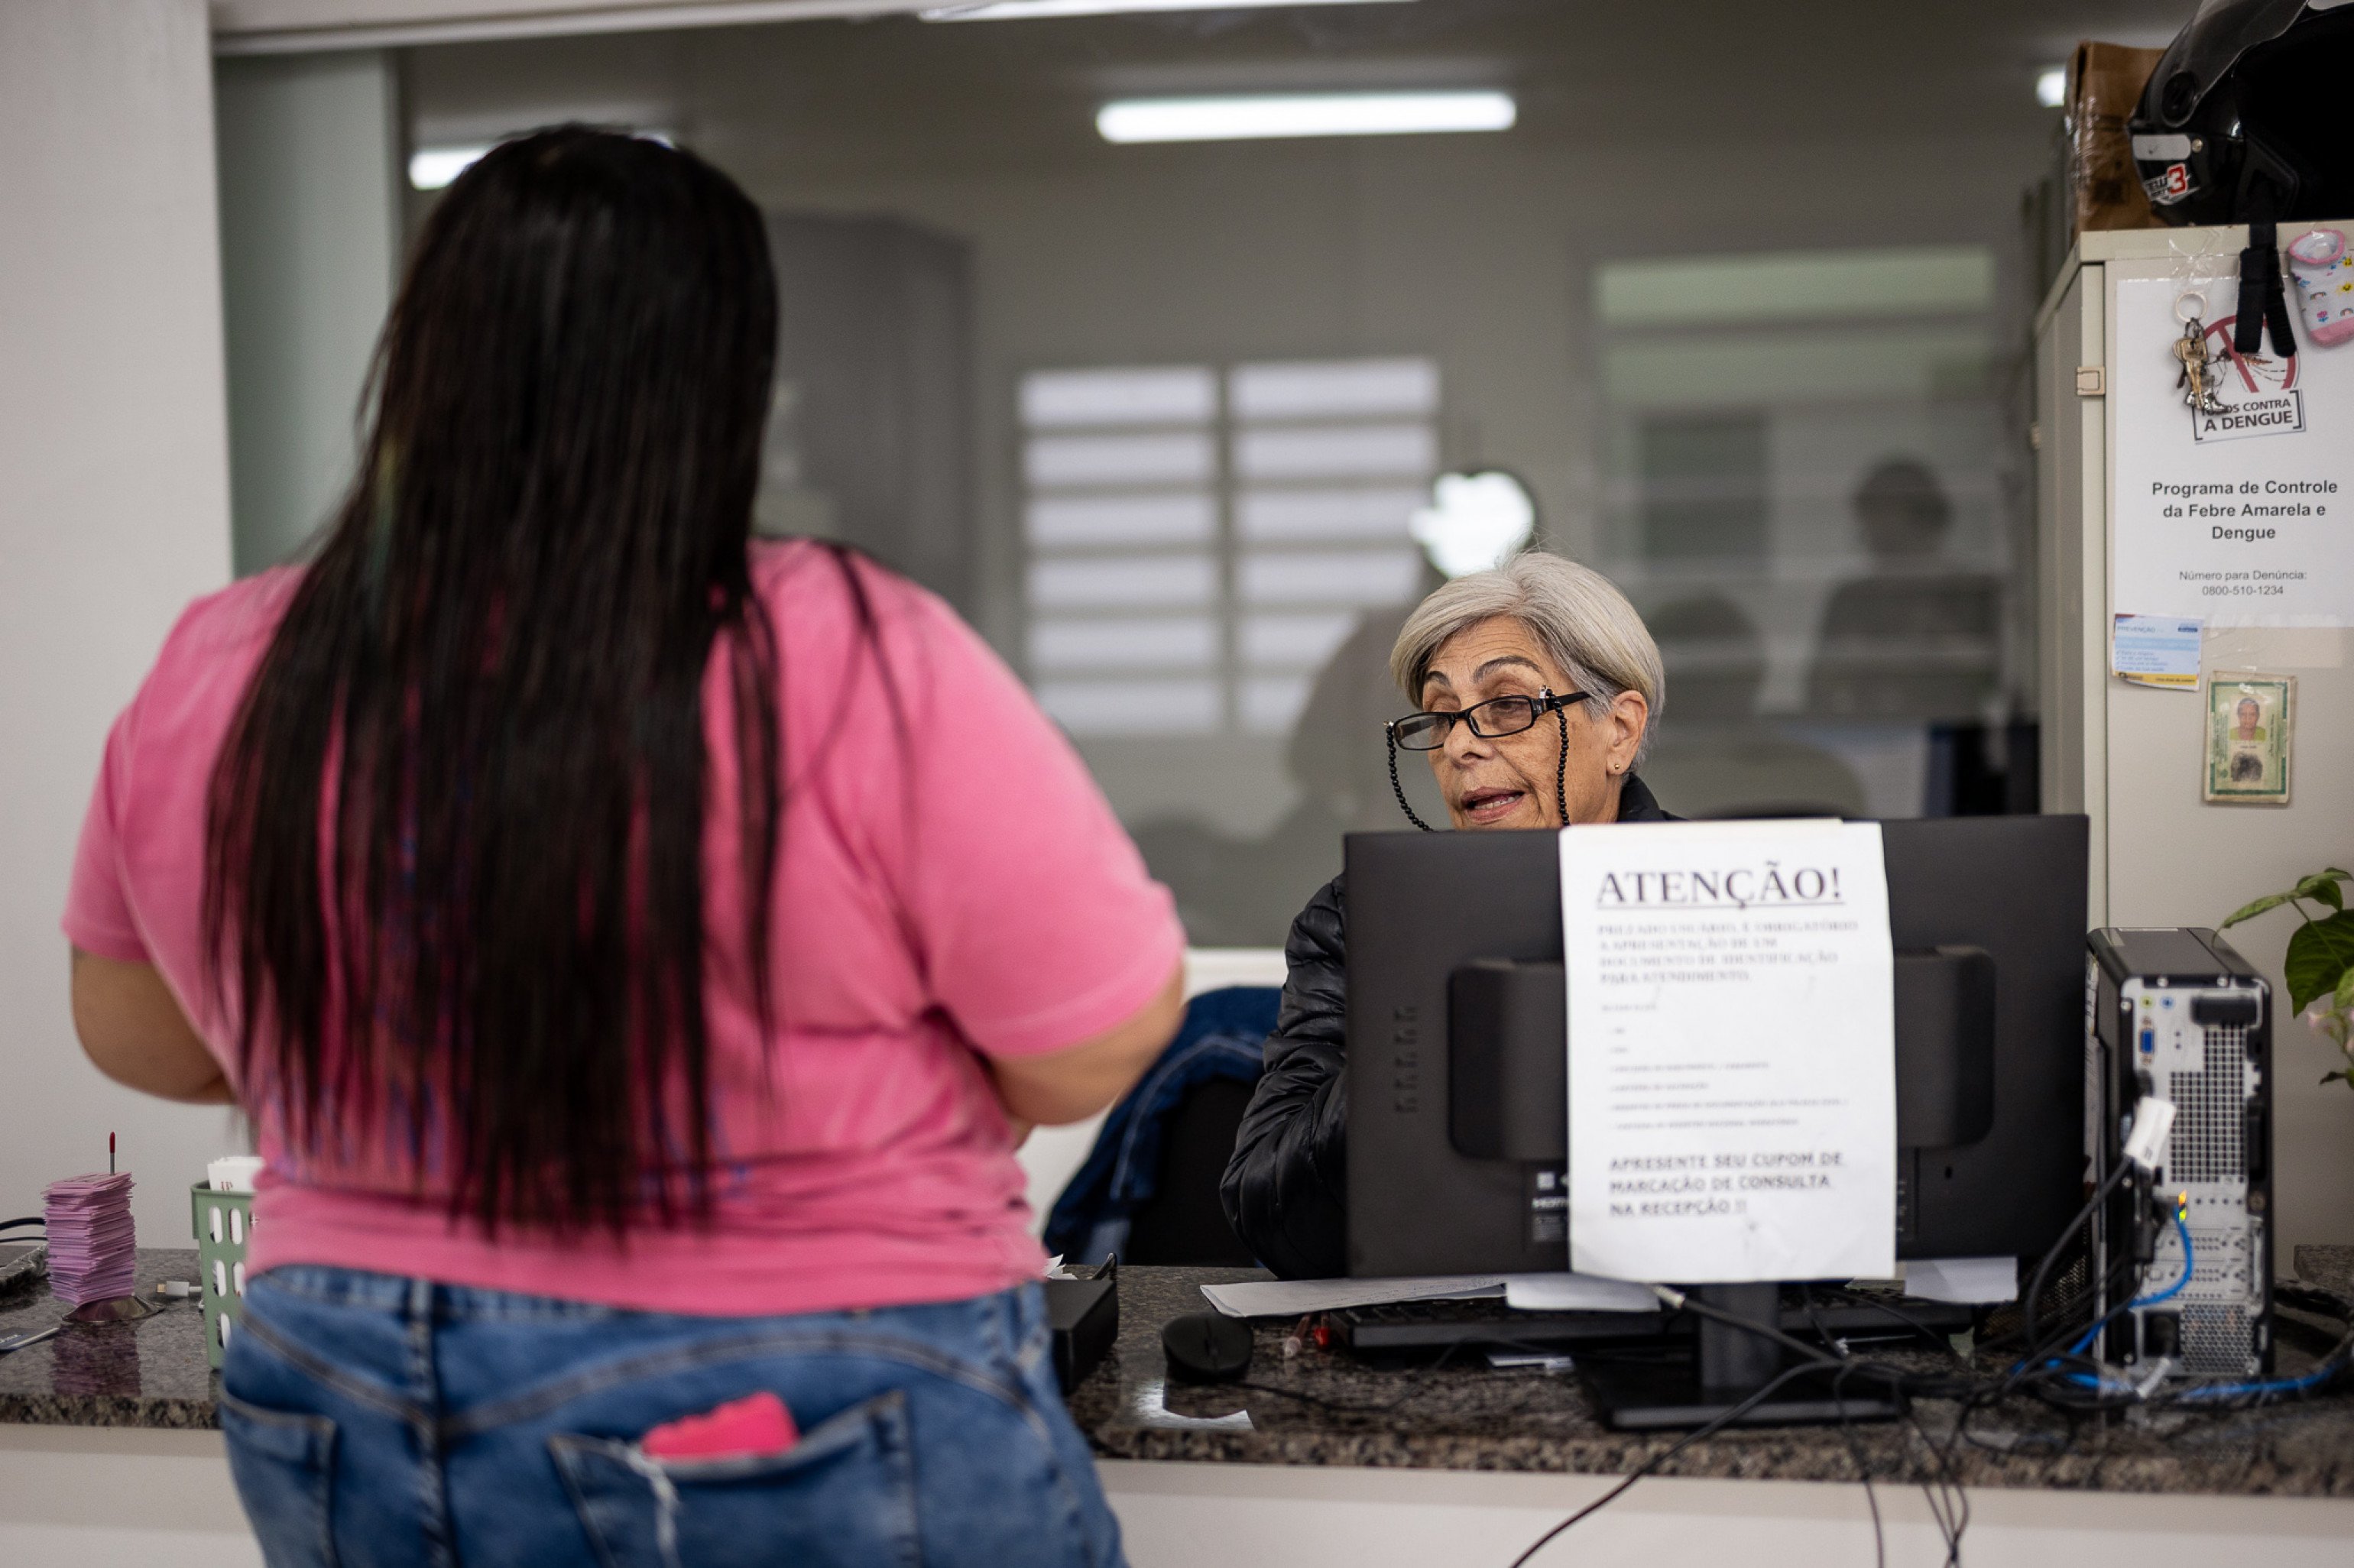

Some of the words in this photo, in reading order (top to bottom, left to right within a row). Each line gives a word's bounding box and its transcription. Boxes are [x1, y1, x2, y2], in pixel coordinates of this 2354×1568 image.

[2243, 398, 2291, 412] CONTRA
[2203, 419, 2217, 432] A
[2222, 410, 2293, 430] DENGUE
[2152, 481, 2234, 499] Programa
[2239, 481, 2259, 494] de
[2265, 479, 2339, 494] Controle
[2162, 504, 2183, 518] da
[2188, 504, 2236, 517] Febre
[2240, 502, 2311, 517] Amarela
[2316, 505, 2326, 517] e
[2212, 525, 2276, 543] Dengue
[2179, 570, 2223, 581] Número
[2224, 572, 2250, 584] para
[2252, 569, 2308, 581] Denúncia:
[2202, 585, 2284, 596] 0800-510-1234
[1597, 860, 1842, 910] ATENÇÃO!
[1730, 937, 1748, 949] DE
[1600, 955, 1695, 967] DOCUMENTO
[1697, 954, 1716, 966] DE
[1600, 971, 1639, 984] PARA
[1609, 1155, 1707, 1172] APRESENTE
[1714, 1154, 1746, 1168] SEU
[1752, 1152, 1814, 1168] CUPOM
[1821, 1152, 1842, 1166] DE
[1609, 1174, 1706, 1194] MARCAÇÃO
[1712, 1175, 1733, 1192] DE
[1740, 1174, 1830, 1191] CONSULTA
[1610, 1202, 1635, 1217] NA
[1641, 1197, 1730, 1216] RECEPÇÃO
